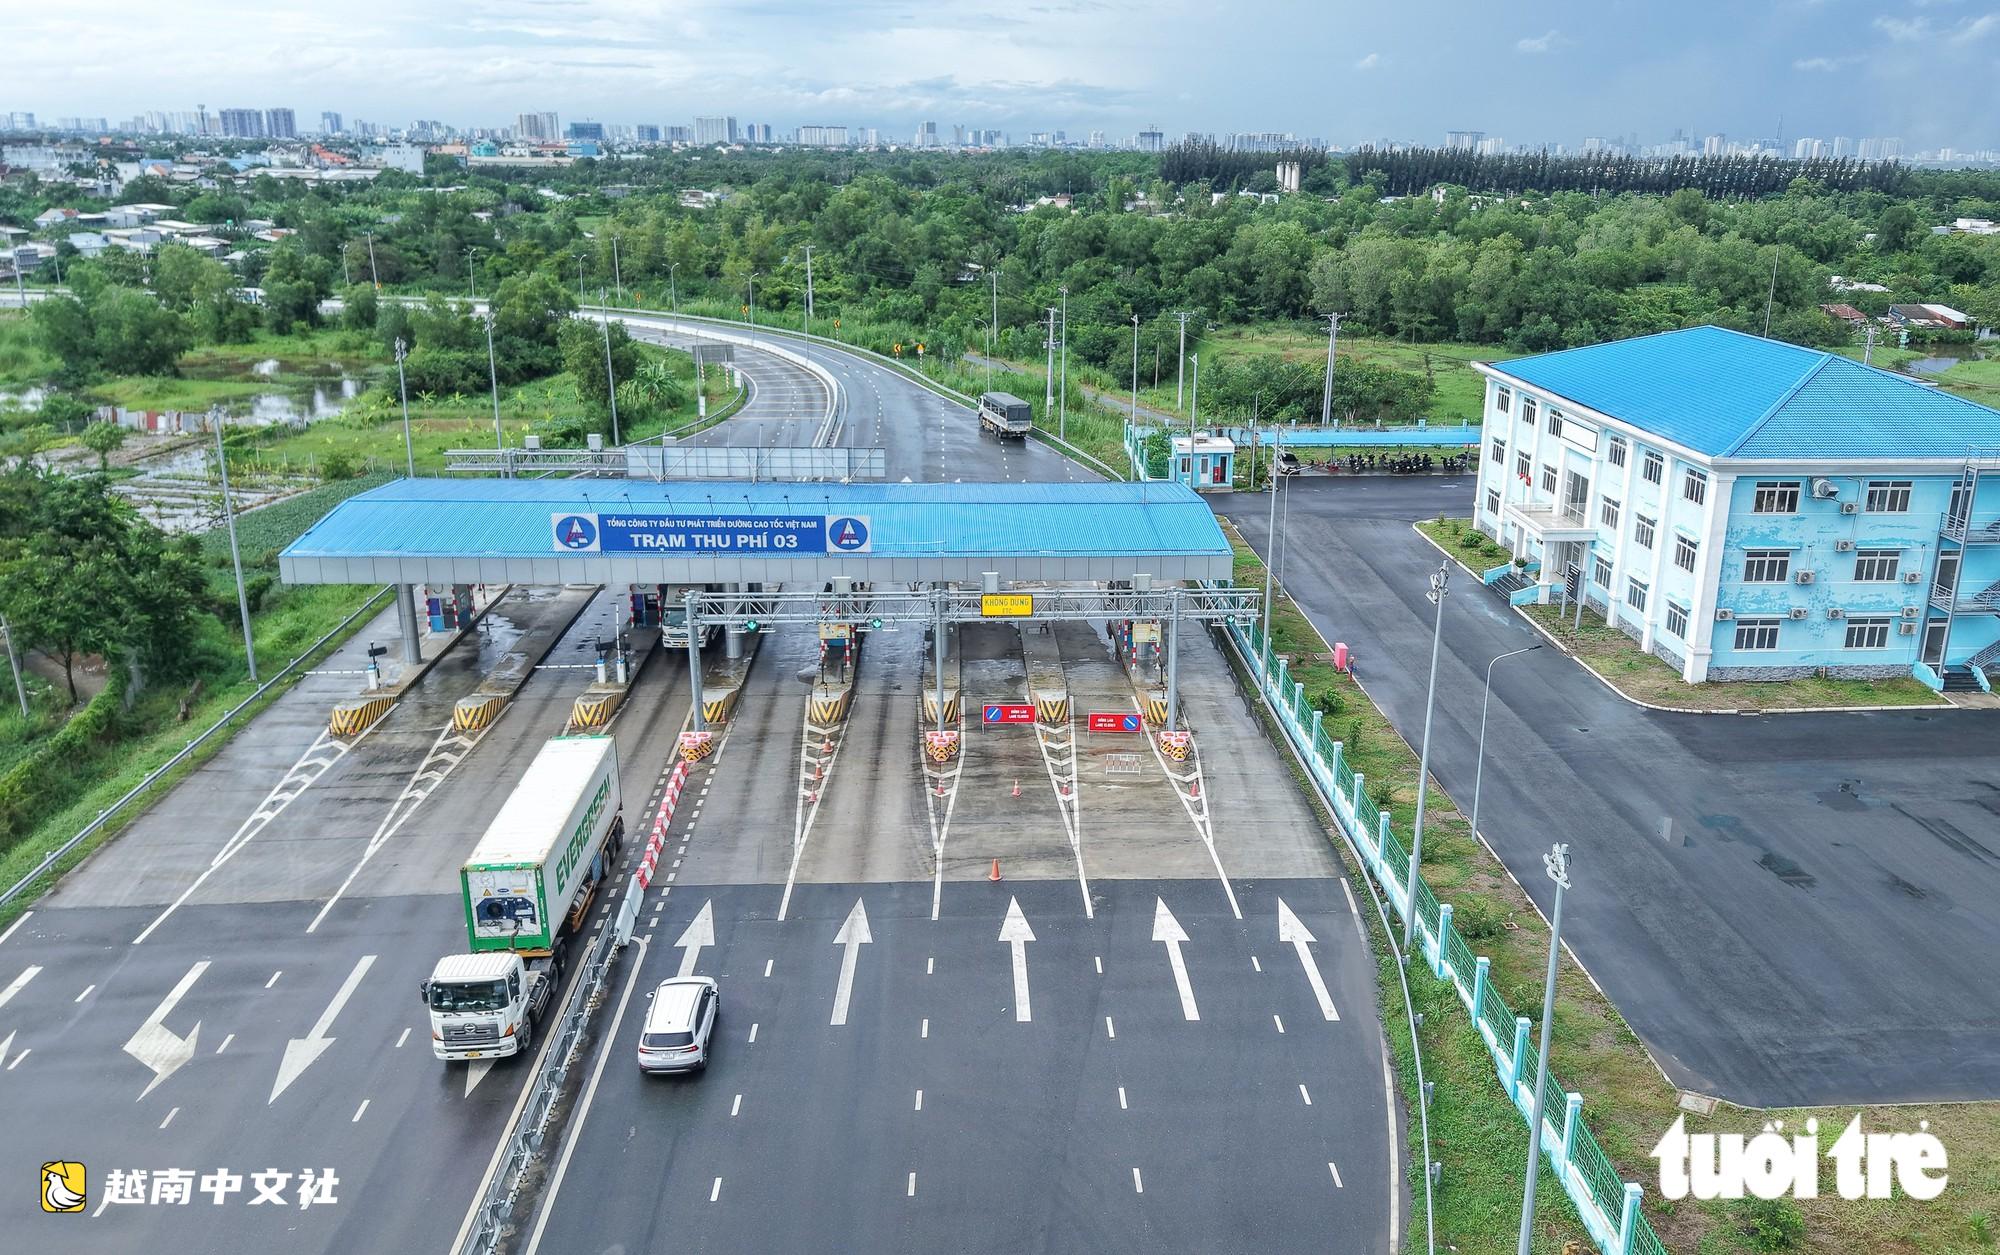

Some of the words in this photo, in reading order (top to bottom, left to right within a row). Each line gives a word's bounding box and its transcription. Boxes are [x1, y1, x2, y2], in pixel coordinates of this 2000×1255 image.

[627, 518, 648, 528] CÔNG
[648, 520, 658, 528] TY
[675, 520, 686, 528] TƯ
[686, 518, 706, 528] PHÁT
[753, 520, 769, 529] CAO
[769, 517, 784, 529] TỐC
[784, 519, 801, 531] VIỆT
[800, 521, 818, 529] NAM
[629, 533, 686, 551] TRẠM
[690, 534, 731, 548] THU
[736, 531, 768, 548] PHÍ
[773, 534, 798, 548] 03
[555, 772, 611, 897] EVERGREEN
